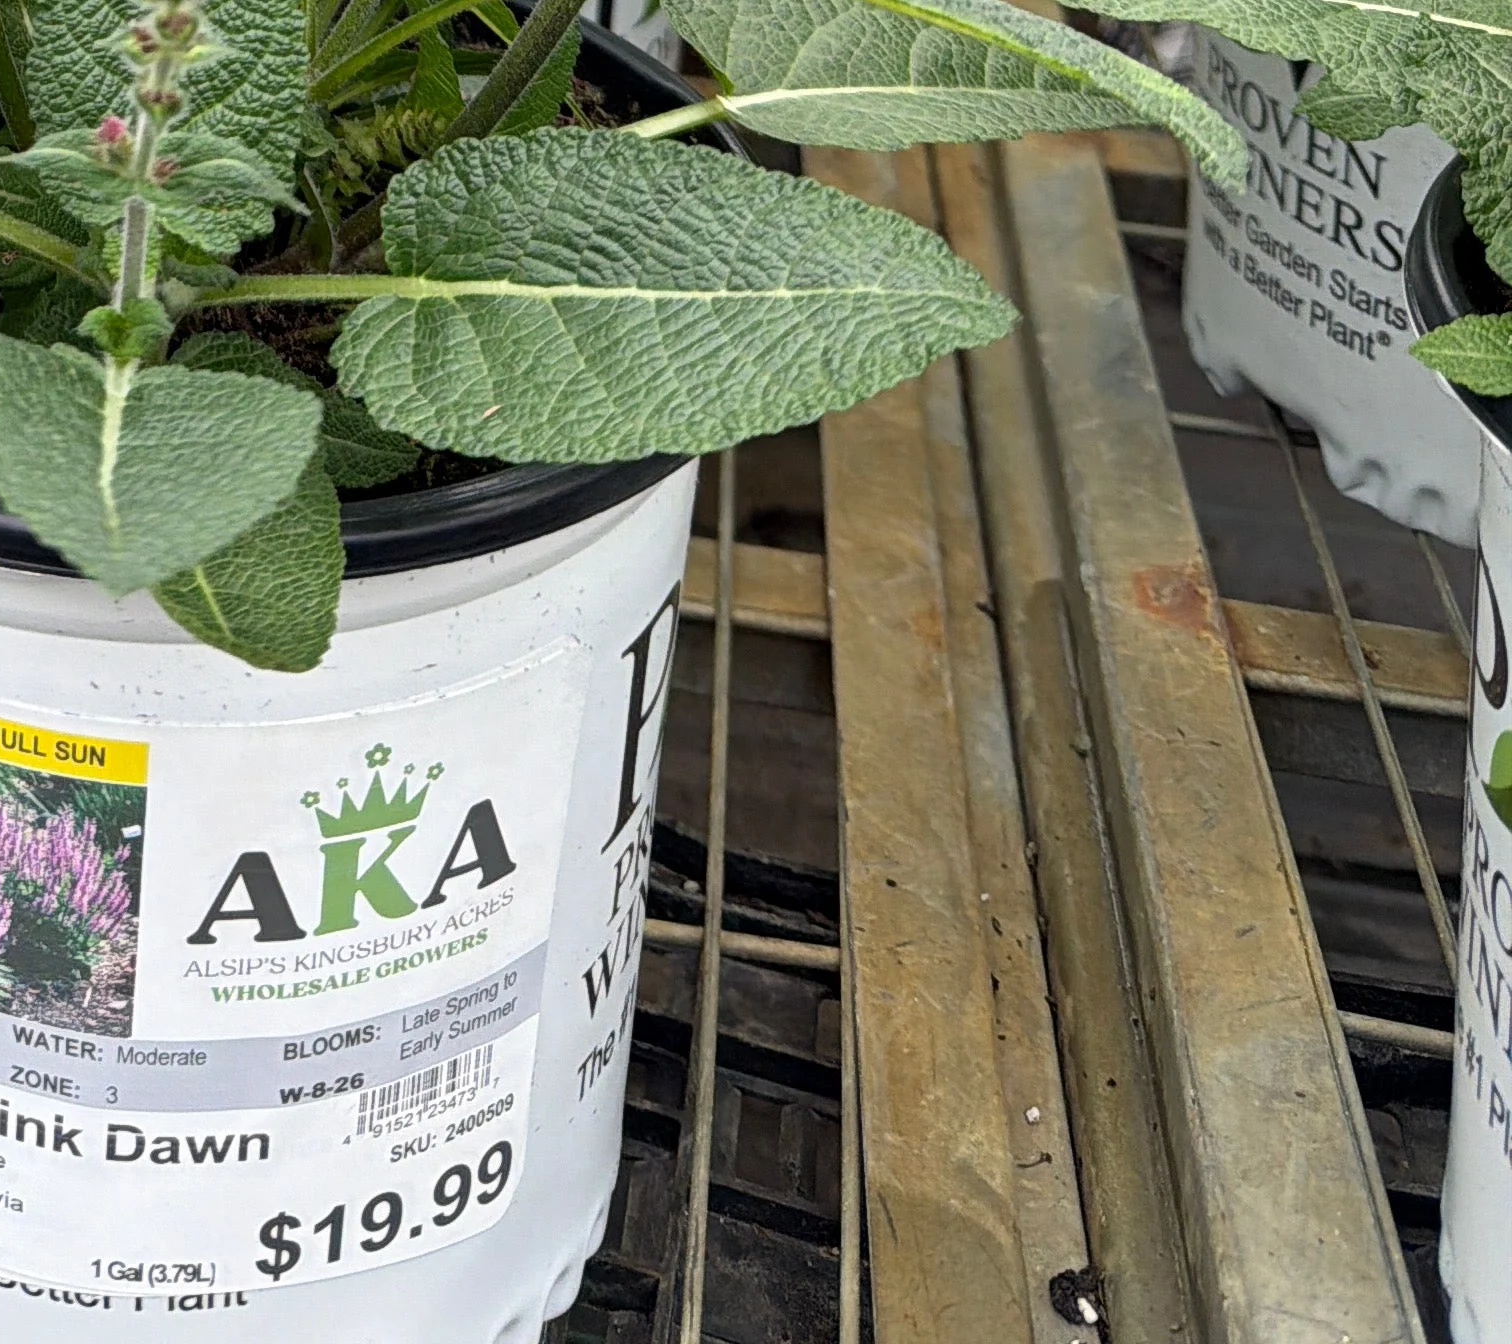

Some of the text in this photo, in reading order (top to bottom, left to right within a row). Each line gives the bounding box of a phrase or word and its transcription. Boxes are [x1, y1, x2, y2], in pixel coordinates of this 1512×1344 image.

[1243, 252, 1305, 319] Better
[1245, 213, 1323, 288] Garden
[1328, 268, 1409, 331] Starts
[54, 740, 107, 768] SUN
[186, 798, 517, 945] AKA
[183, 886, 516, 979] ALSIP'S KINGSBURY ACRES
[211, 927, 489, 1004] WHOLESALE GROWERS
[11, 1023, 207, 1067] WATER: Moderate
[283, 970, 518, 1062] BLOOMS: Late Spring to
[399, 995, 519, 1061] Early Summer
[10, 1064, 119, 1105] ZONE: 3
[279, 1072, 365, 1105] W-8-26
[577, 1029, 616, 1102] The
[105, 1123, 270, 1164] Dawn
[389, 1092, 515, 1164] SKU: 2400509
[254, 1139, 514, 1283] $19.99
[91, 1258, 217, 1289] 1 Gal (3.79L)
